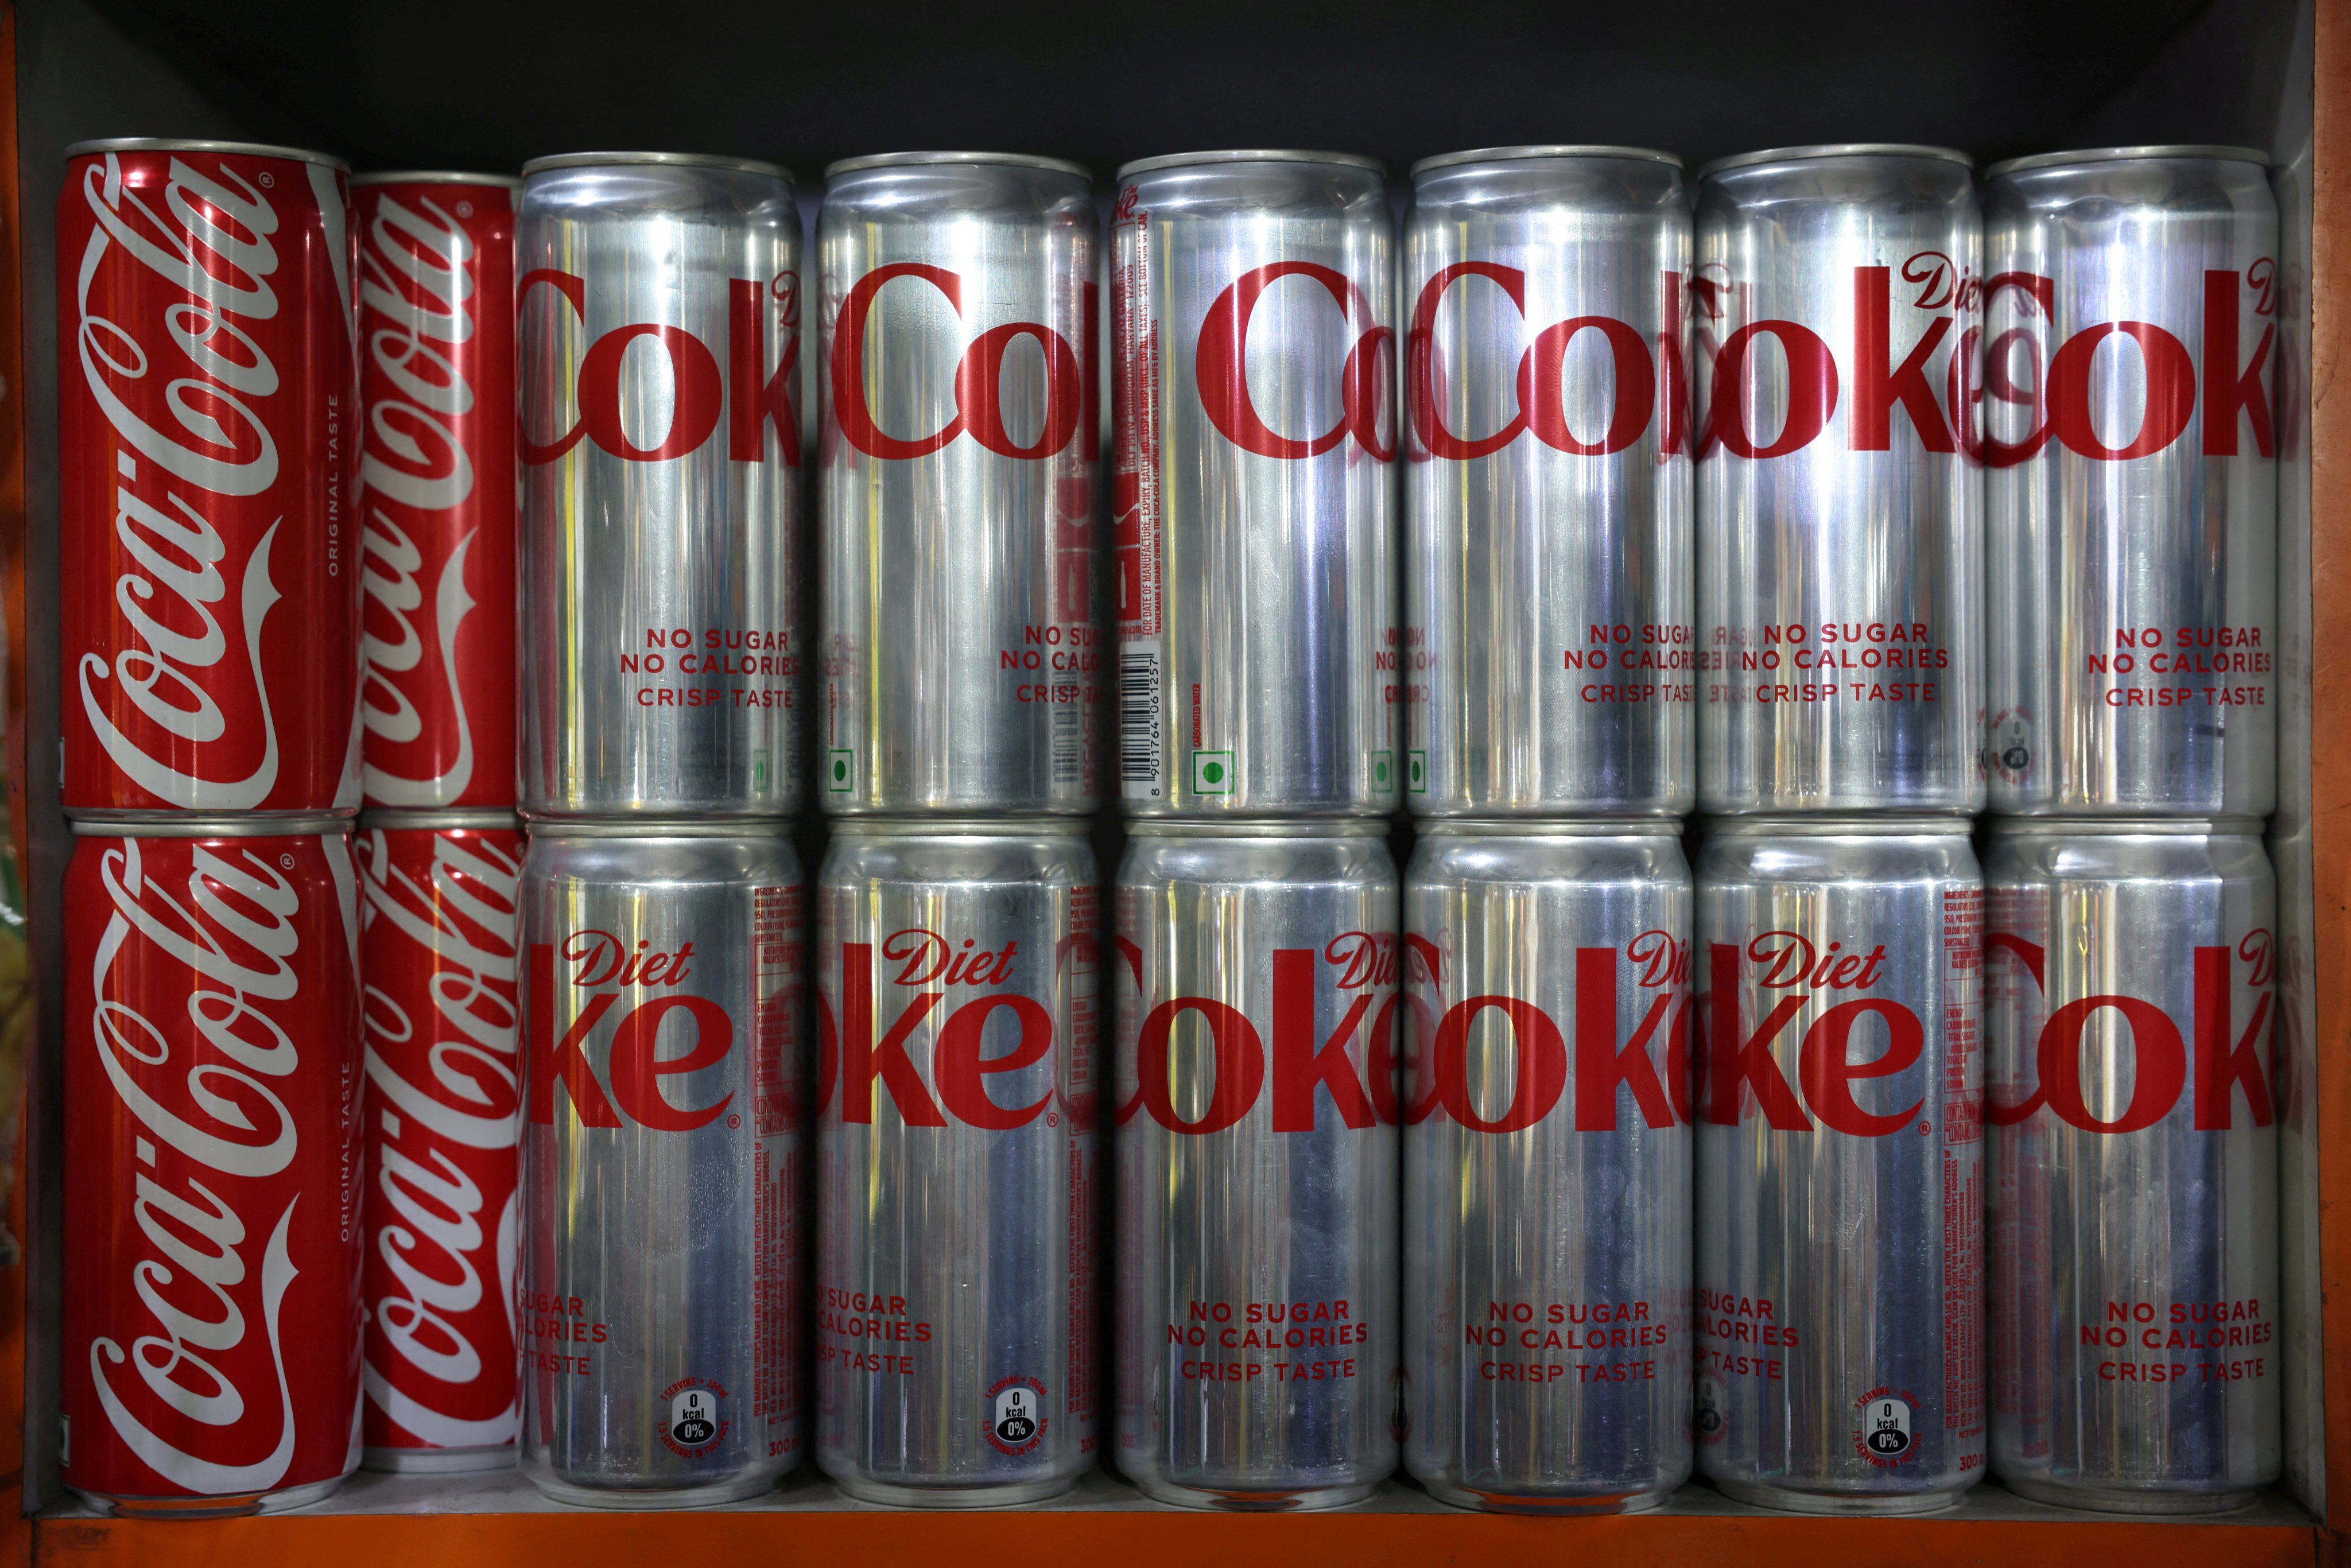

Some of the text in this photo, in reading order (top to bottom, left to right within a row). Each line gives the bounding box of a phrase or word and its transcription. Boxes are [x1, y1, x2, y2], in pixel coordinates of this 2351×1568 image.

[1138, 211, 1147, 230] CAN.
[1138, 246, 1147, 280] BOTTOM
[1126, 265, 1134, 298] 122009
[1138, 283, 1148, 297] SEE
[1126, 309, 1135, 354] HARYANA
[1139, 334, 1149, 349] ALL
[832, 262, 1099, 462] Co
[1139, 351, 1149, 362] OF
[1151, 352, 1158, 361] BY
[518, 268, 802, 467] Cok
[1139, 364, 1150, 388] (INCL.
[1984, 270, 2276, 468] Cok
[1152, 379, 1158, 387] AS
[1139, 391, 1150, 408] MRP
[1139, 419, 1150, 434] USP
[1128, 433, 1136, 447] PH
[1128, 450, 1136, 467] DLF
[1140, 457, 1151, 482] BATCH
[328, 395, 338, 577] ORIGINAL TASTE
[1140, 485, 1152, 515] EXPIRY,
[1141, 518, 1153, 582] MANUFACTURE,
[1142, 584, 1152, 595] OF
[1142, 597, 1152, 617] DATE
[1025, 626, 1061, 645] NO
[1070, 627, 1099, 647] SUG
[1142, 620, 1152, 635] FOR
[1590, 624, 1631, 644] NO
[1765, 623, 1927, 644] NO SUGAR
[2117, 627, 2261, 647] NO SUGAR
[647, 629, 788, 651] NO SUGAR
[620, 654, 799, 676] NO CALORIES
[1002, 650, 1041, 670] NO
[1565, 650, 1607, 670] NO
[1743, 649, 1948, 670] NO CALORIES
[2089, 653, 2271, 673] NO CALORIES
[637, 688, 793, 708] CRISP TASTE
[1017, 685, 1080, 703] CRISP
[1581, 685, 1695, 703] CRISP TAST
[1756, 684, 1935, 703] CRISP TASTE
[2106, 687, 2264, 707] CRISP TASTE
[1192, 684, 1201, 747] CARBONATED WATER
[1150, 658, 1159, 797] 8 901764 061257
[561, 929, 695, 987] Diet
[882, 929, 1018, 986] Diet
[1748, 931, 1886, 989] Diet
[1984, 933, 2276, 1134] Cok
[341, 1062, 350, 1243] ORIGINAL TASTE
[1944, 1150, 1951, 1158] OF
[521, 1288, 584, 1317] SUGAR
[828, 1288, 906, 1316] SUGAR
[1190, 1300, 1349, 1323] NO SUGAR
[1490, 1301, 1649, 1324] NO SUGAR
[1700, 1288, 1773, 1319] SUGAR
[2108, 1299, 2260, 1323] NO SUGAR
[818, 1309, 932, 1342] CALORIES
[1168, 1322, 1367, 1348] NO CALORIES
[2080, 1322, 2272, 1349] NO CALORIES
[1466, 1324, 1666, 1349] NO CALORIES
[529, 1350, 592, 1376] TASTE
[841, 1349, 914, 1375] TASTE
[1181, 1359, 1355, 1381] CRISP TASTE
[1480, 1360, 1655, 1383] CRISP TASTE
[1712, 1350, 1782, 1379] TASTE
[2098, 1358, 2264, 1382] CRISP TASTE
[689, 1394, 698, 1408] 0
[1012, 1392, 1020, 1406] 0
[1859, 1387, 1890, 1406] SERVING
[682, 1408, 705, 1419] kcal
[1006, 1406, 1026, 1418] kcal
[1884, 1403, 1892, 1417] 0
[685, 1422, 704, 1438] 0%
[1008, 1420, 1026, 1436] 0%
[1877, 1418, 1898, 1429] kcal
[1855, 1442, 1887, 1468] SERVINGS
[1890, 1460, 1898, 1468] IN
[1897, 1450, 1914, 1466] THIS
[1911, 1432, 1922, 1451] PACK
[1879, 1433, 1898, 1448] 0%
[1960, 1453, 1977, 1471] 300
